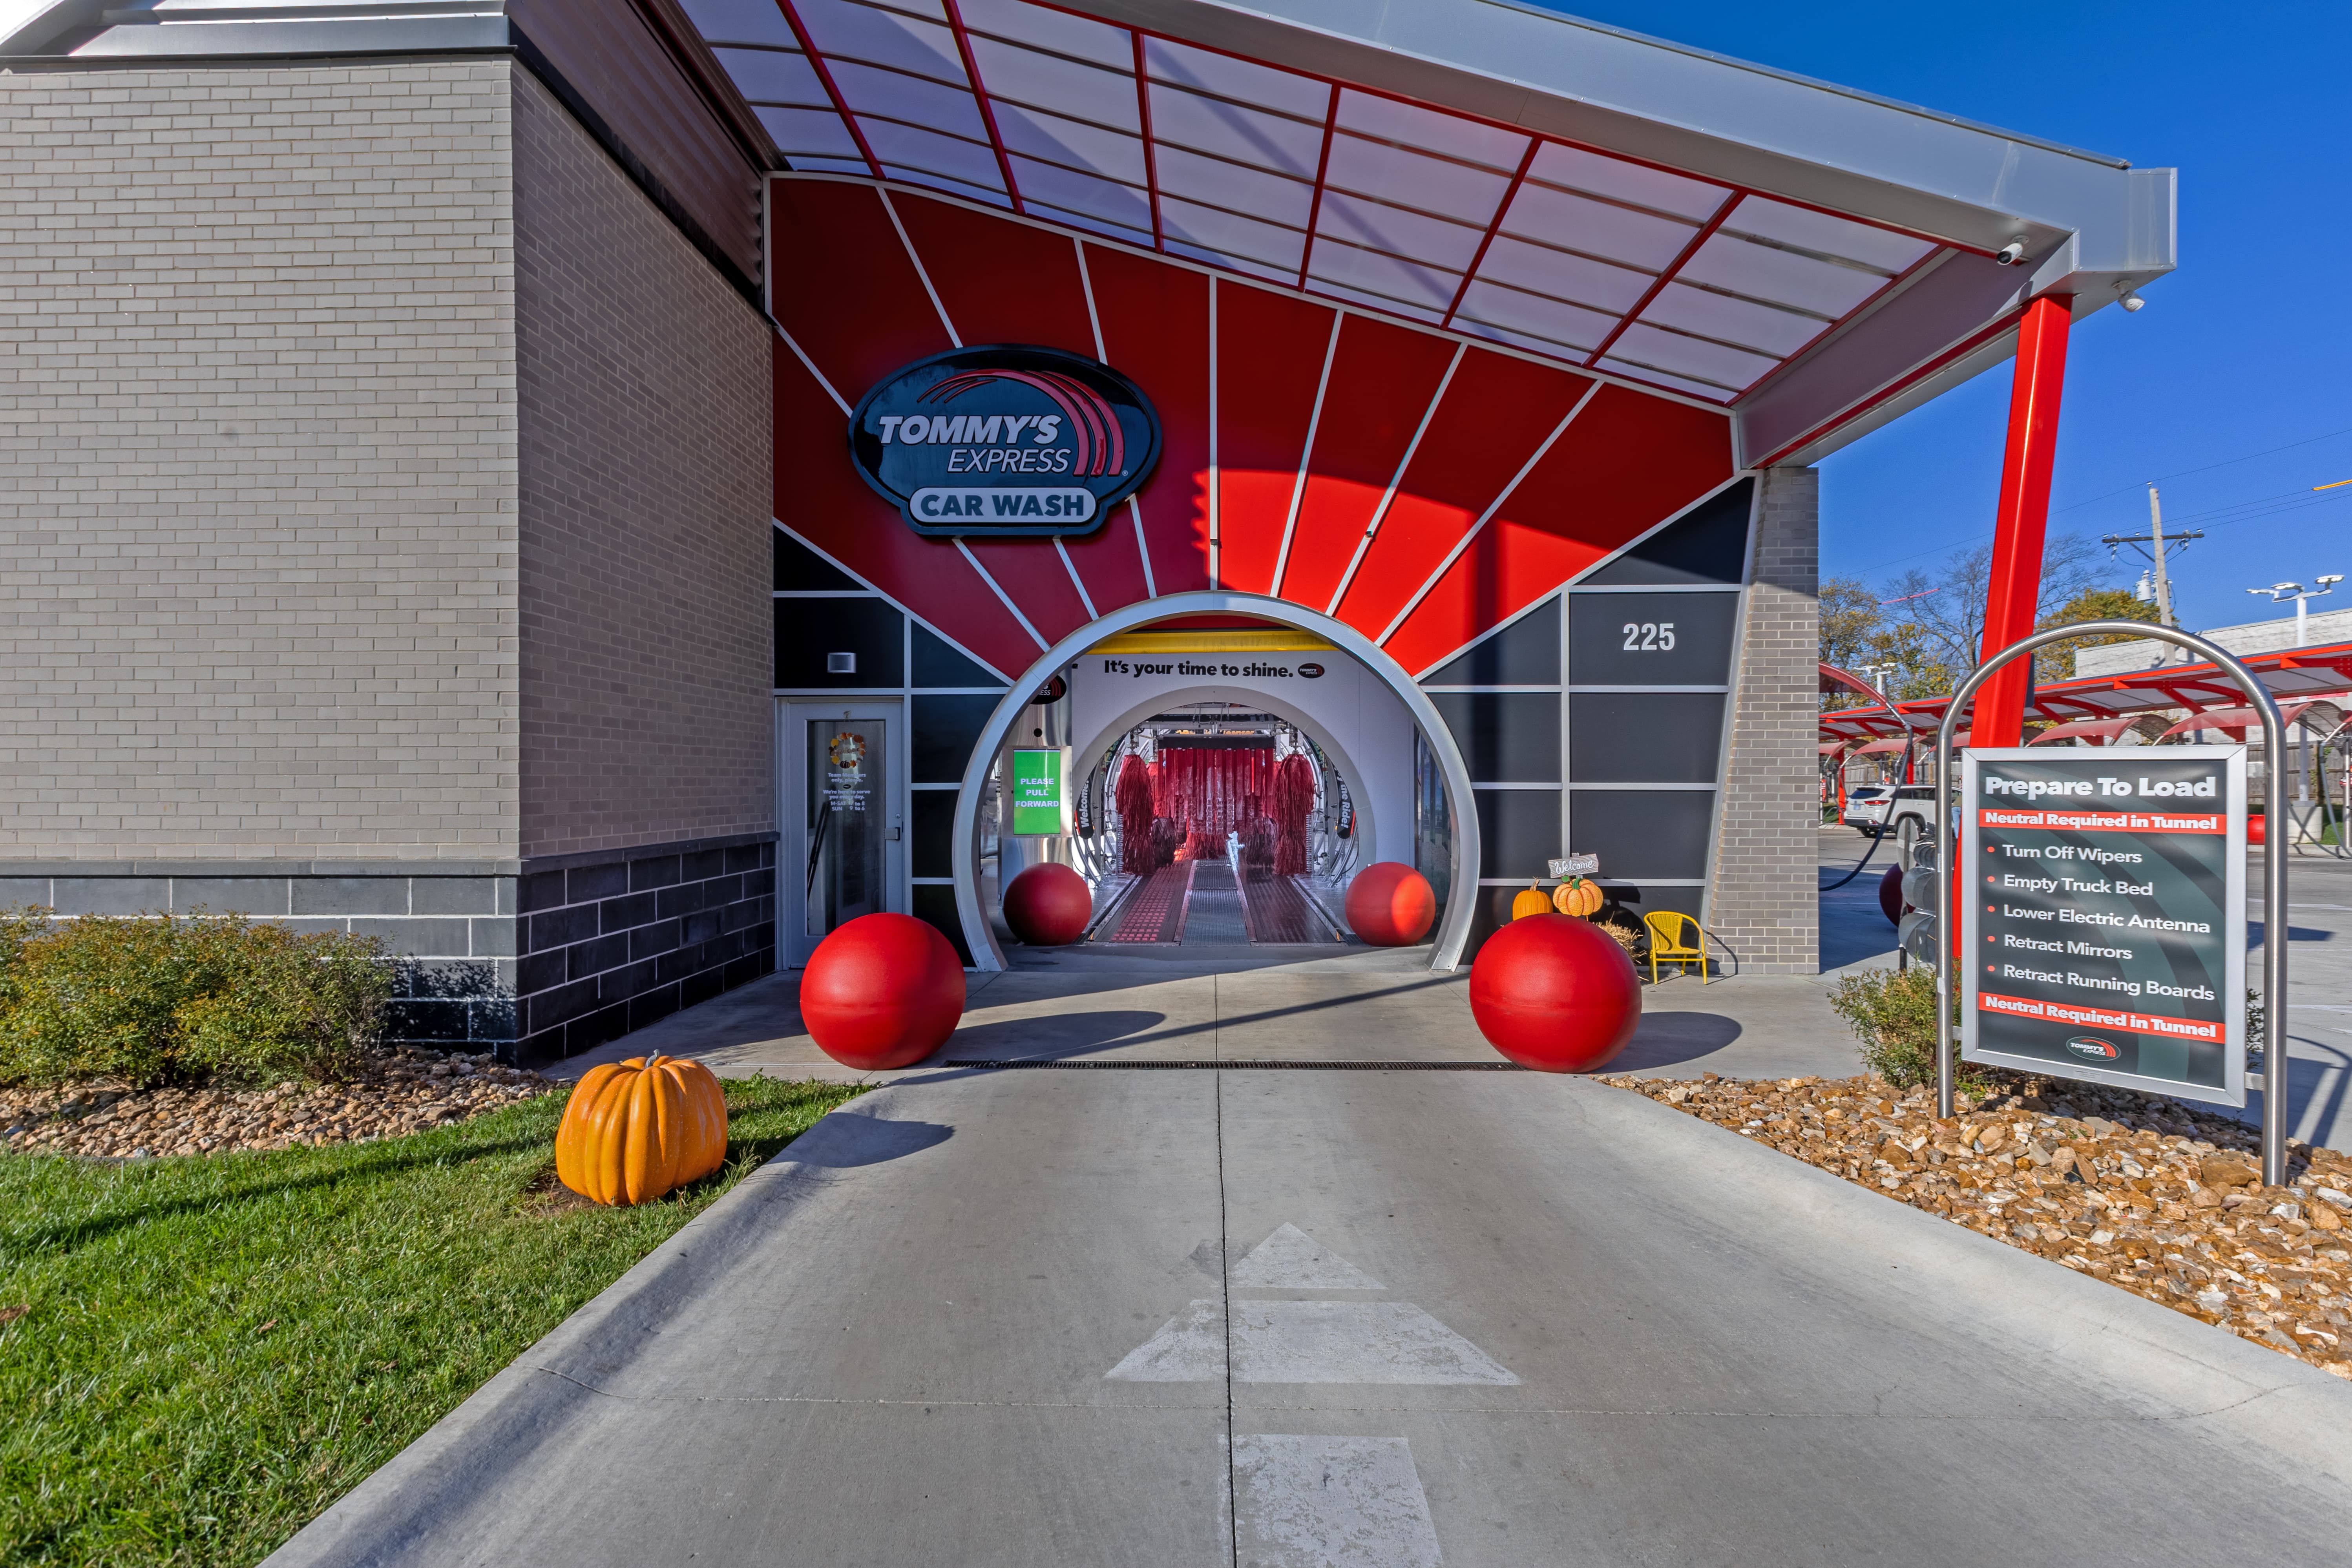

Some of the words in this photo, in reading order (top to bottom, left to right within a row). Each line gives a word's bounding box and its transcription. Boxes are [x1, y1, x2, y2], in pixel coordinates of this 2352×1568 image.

[879, 415, 1062, 444] TOMMY'S
[947, 449, 1072, 472] EXPRESS
[920, 495, 984, 517] CAR
[992, 495, 1084, 517] WASH
[1623, 623, 1675, 651] 225
[1104, 660, 1129, 674] It's
[1134, 663, 1174, 678] your
[1178, 661, 1217, 676] time
[1221, 663, 1239, 676] to
[1242, 663, 1294, 677] shine.
[1985, 777, 2093, 800] Prepare
[2097, 778, 2132, 796] To
[2138, 776, 2216, 797] Load
[1341, 801, 1351, 829] Ride!
[1985, 812, 2043, 825] Neutral
[2047, 814, 2127, 829] Required
[2131, 815, 2149, 827] in
[2151, 816, 2217, 829] Tunnel
[2002, 844, 2041, 858] Turn
[2045, 846, 2075, 860] Off
[2077, 847, 2143, 865] Wipers
[1554, 860, 1594, 874] Welcome
[2004, 874, 2058, 893] Empty
[2061, 878, 2111, 893] Truck
[2116, 881, 2153, 896] Bed
[2004, 904, 2055, 920] Lower
[2059, 909, 2124, 927] Electric
[2127, 915, 2211, 933] Antenna
[2004, 935, 2064, 953] Retract
[2067, 941, 2133, 959] Mirrors
[2004, 964, 2063, 984] Retract
[2067, 973, 2140, 996] Running
[2146, 980, 2215, 1001] Boards
[1985, 995, 2043, 1015] Neutral
[2047, 1004, 2127, 1027] Required
[2130, 1015, 2149, 1030] in
[2150, 1018, 2216, 1037] Tunnel
[2070, 1042, 2104, 1051] TOMMY'S
